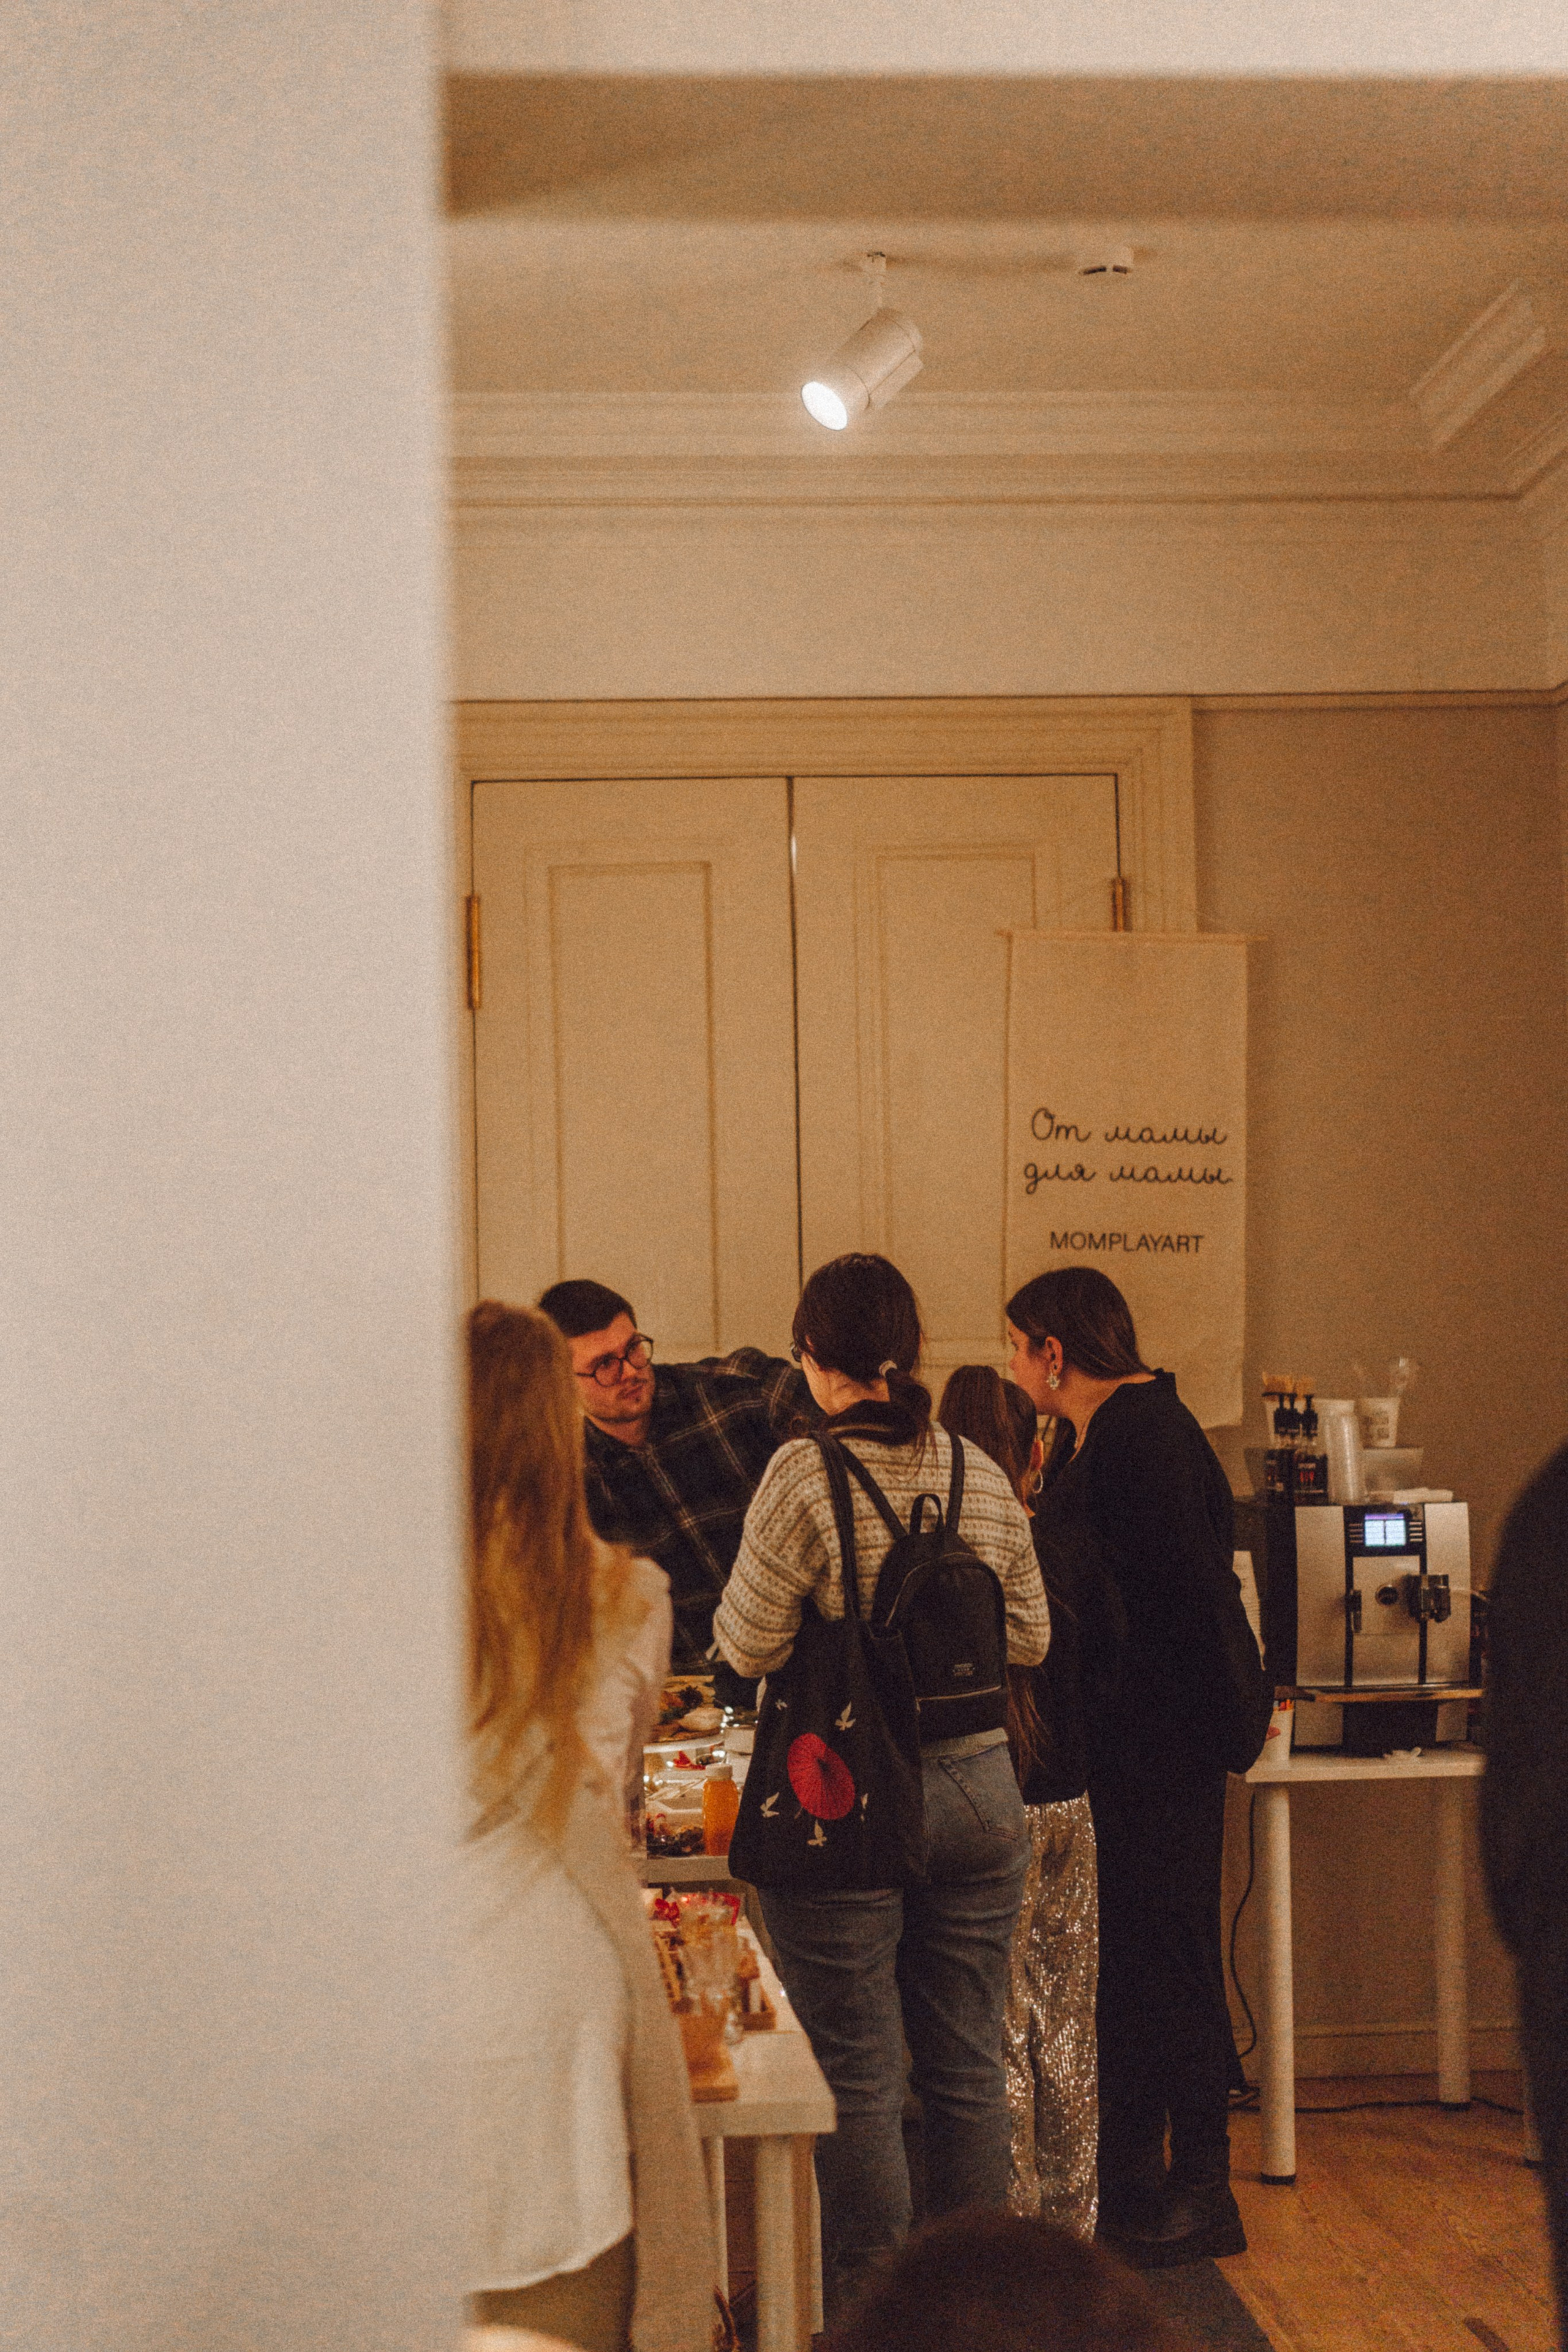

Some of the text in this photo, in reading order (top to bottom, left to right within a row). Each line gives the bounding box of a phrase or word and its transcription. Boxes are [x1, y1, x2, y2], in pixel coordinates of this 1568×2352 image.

[1031, 1107, 1228, 1145] От мамы
[1023, 1163, 1234, 1195] для мамы
[1050, 1231, 1204, 1253] MOMPLAYART
